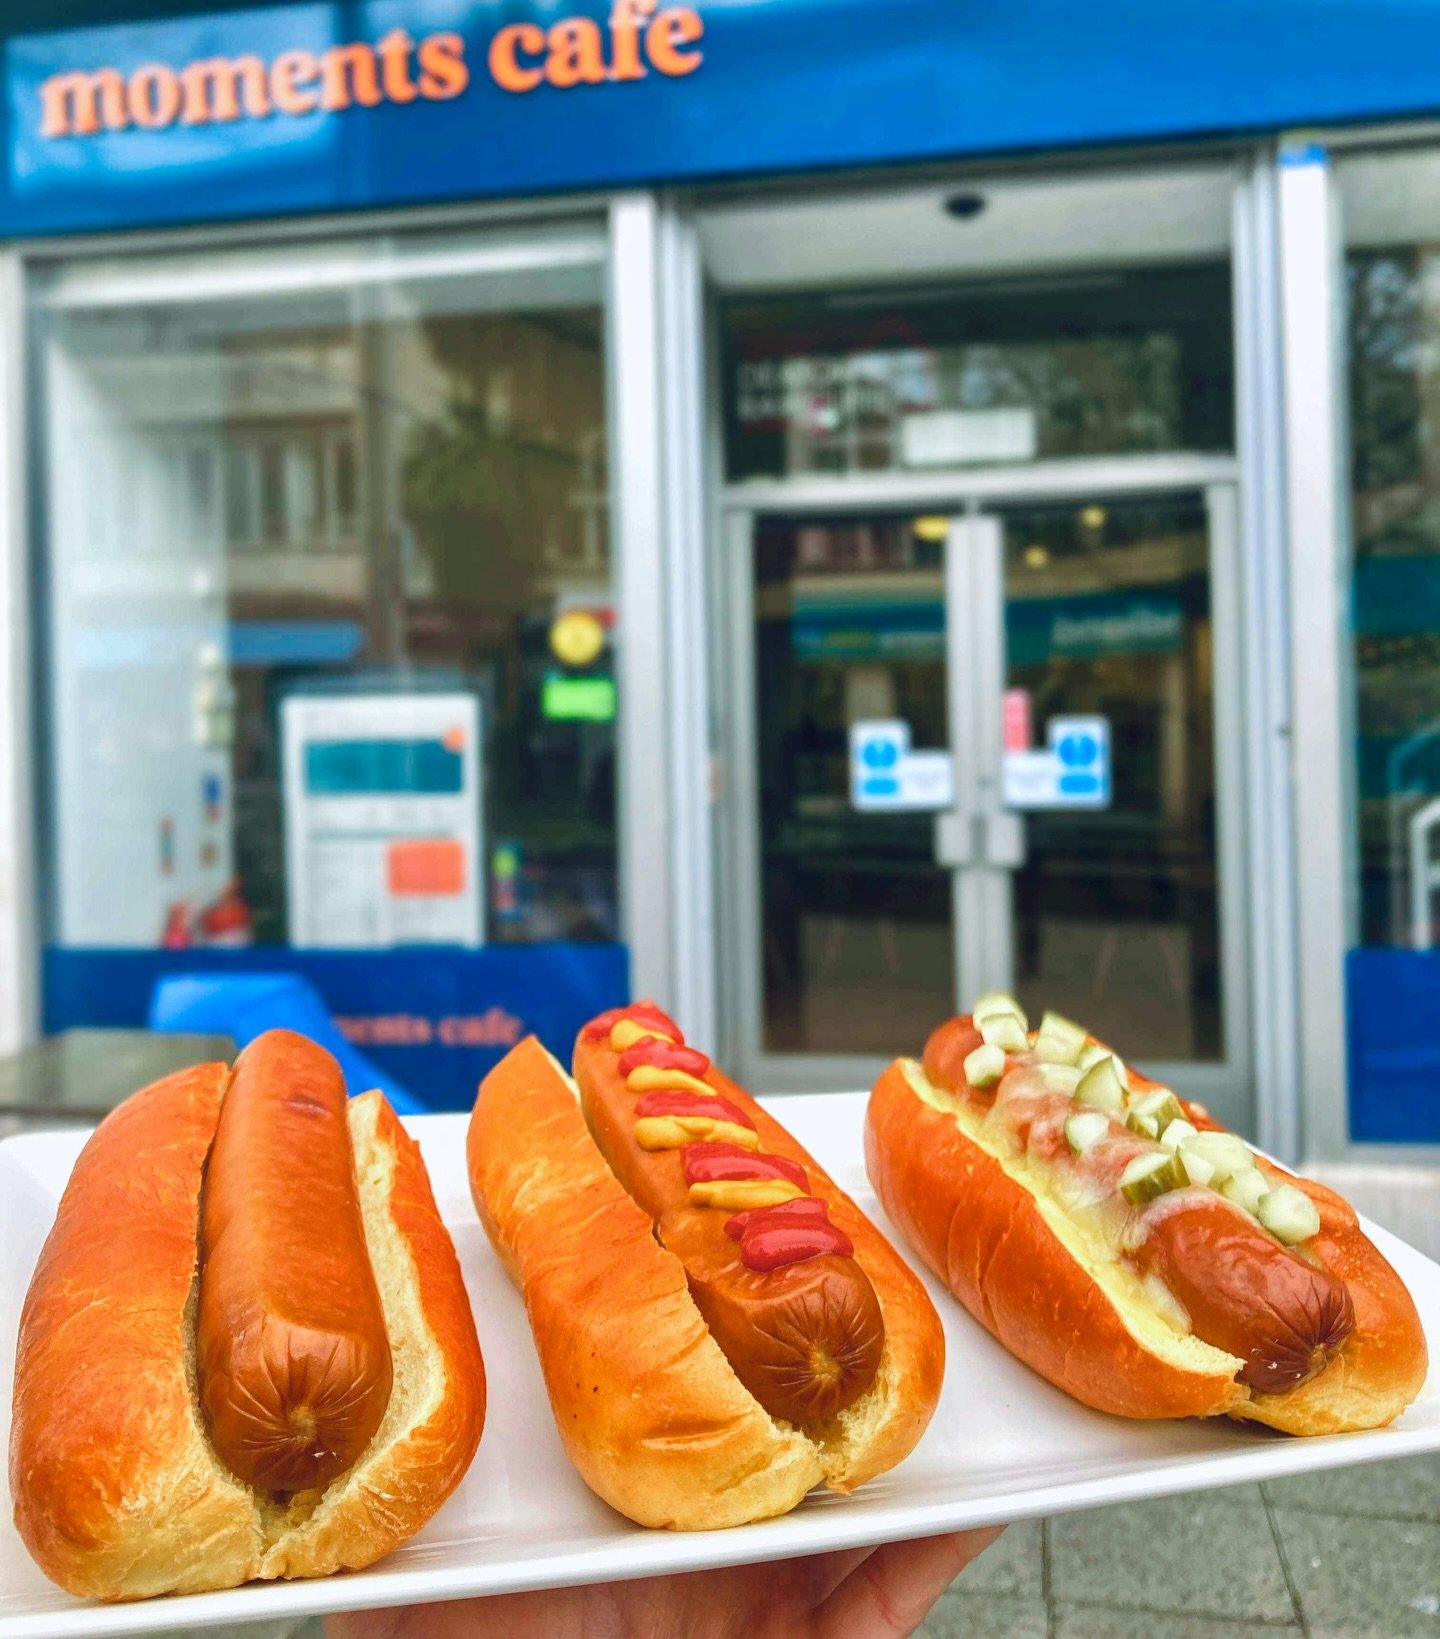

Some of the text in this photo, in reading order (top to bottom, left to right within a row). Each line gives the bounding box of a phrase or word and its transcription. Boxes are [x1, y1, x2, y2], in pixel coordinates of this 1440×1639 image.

[40, 0, 704, 137] moments cafe
[437, 1006, 523, 1046] cafe
